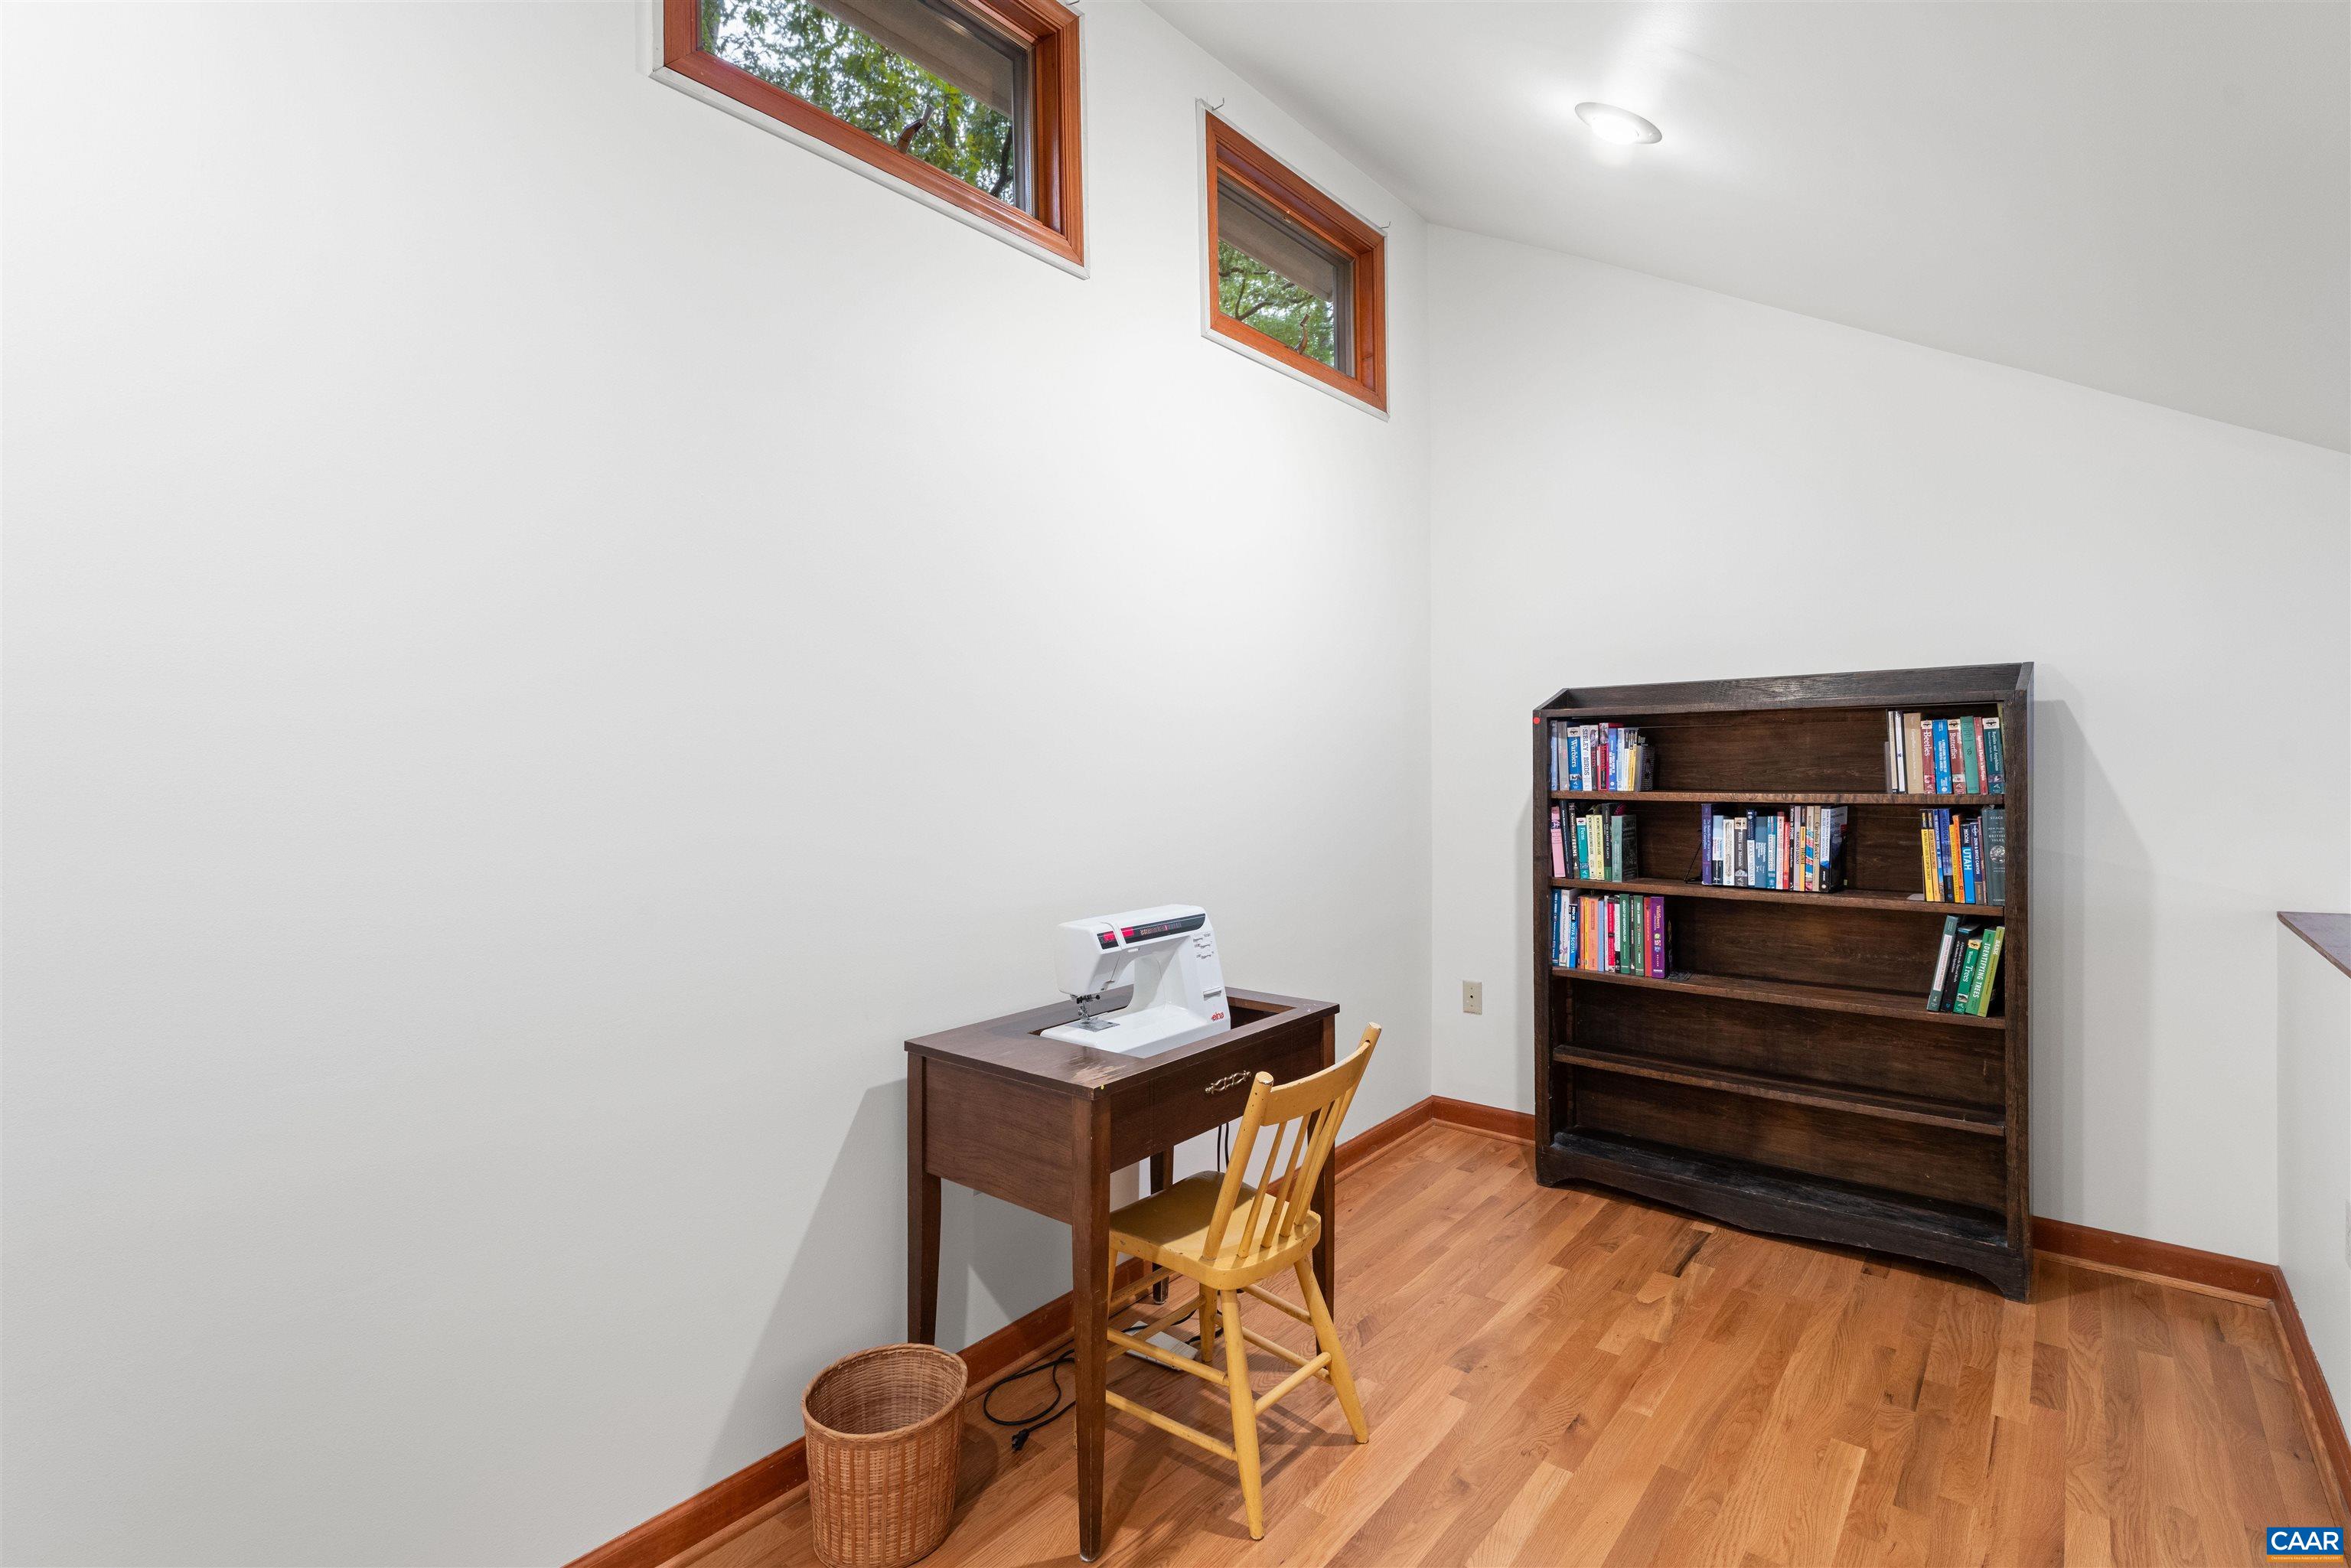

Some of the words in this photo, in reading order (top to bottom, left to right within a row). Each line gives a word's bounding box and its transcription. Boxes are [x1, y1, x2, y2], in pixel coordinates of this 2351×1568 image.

[1924, 732, 1932, 756] Beetles
[1963, 849, 1972, 870] UTAH
[1977, 943, 1991, 980] IDENTIFYING
[1963, 965, 1973, 982] Trees
[1973, 982, 1982, 998] TREES
[1211, 1012, 1224, 1022] elna
